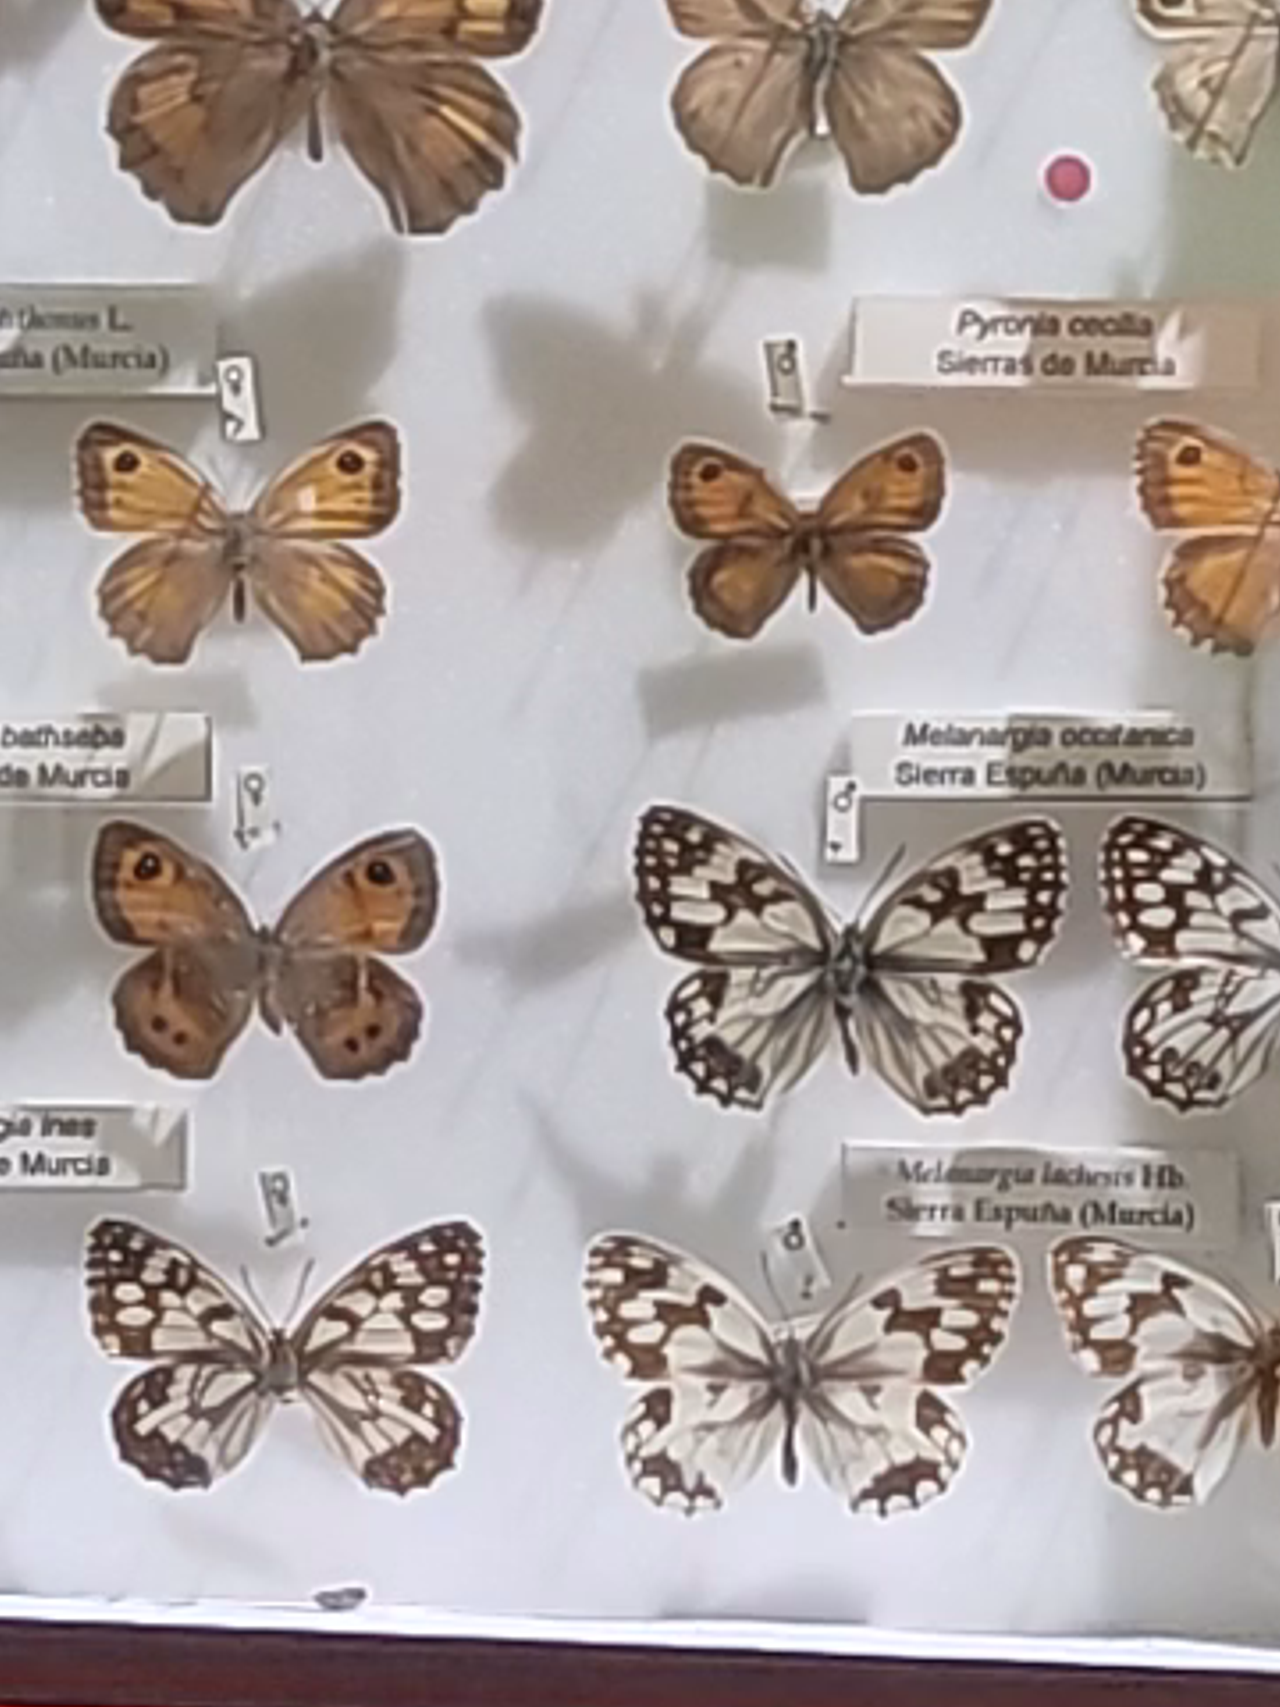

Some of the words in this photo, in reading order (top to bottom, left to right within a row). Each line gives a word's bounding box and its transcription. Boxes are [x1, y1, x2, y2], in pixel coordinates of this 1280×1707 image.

[52, 345, 170, 374] (Murcia)
[37, 765, 131, 790] Murcia
[896, 761, 975, 786] Sierra
[986, 761, 1088, 793] Espuña
[1096, 760, 1208, 791] (Murcia)
[20, 1152, 111, 1177] Murcia
[974, 1199, 1071, 1230] Espuña
[1079, 1200, 1196, 1231] (Murcia)
